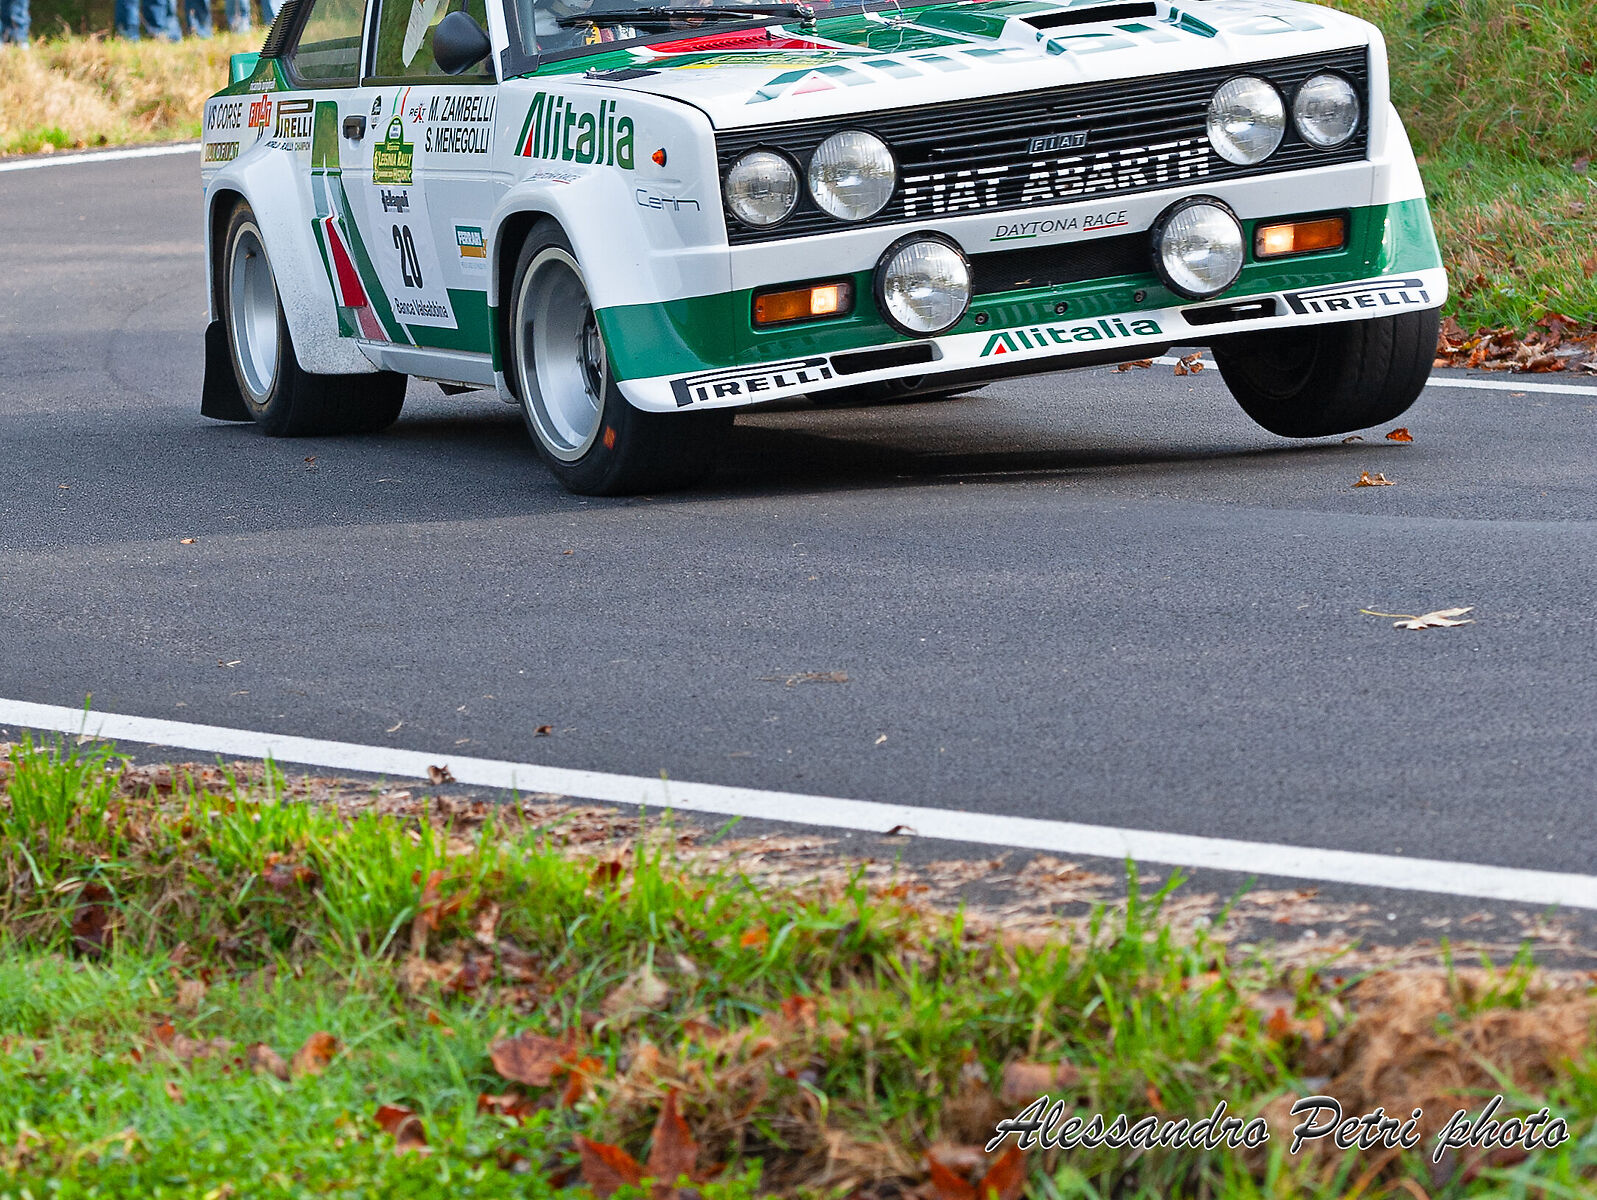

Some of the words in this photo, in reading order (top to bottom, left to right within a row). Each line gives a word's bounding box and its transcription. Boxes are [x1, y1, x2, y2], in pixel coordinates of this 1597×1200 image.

[217, 103, 243, 129] CORSE
[248, 95, 273, 128] FIAT
[273, 99, 314, 138] PIRELLI
[428, 96, 439, 121] M.
[441, 96, 496, 121] ZAMBELLI
[425, 127, 433, 152] S.
[435, 128, 490, 153] MENEGOLLI
[514, 92, 635, 170] Alitalia
[1032, 133, 1085, 152] FIAT
[904, 166, 1009, 217] FIAT
[1021, 137, 1210, 203] ABARTH
[636, 188, 701, 211] Cerin
[996, 217, 1077, 238] DAYTONA
[1083, 210, 1127, 228] RACE
[392, 224, 424, 289] 20
[394, 297, 415, 315] Banca
[412, 299, 448, 318] Valsabbina
[1283, 278, 1430, 315] PIRELLI
[980, 318, 1163, 357] Alitalia
[669, 357, 833, 408] PIRELLI
